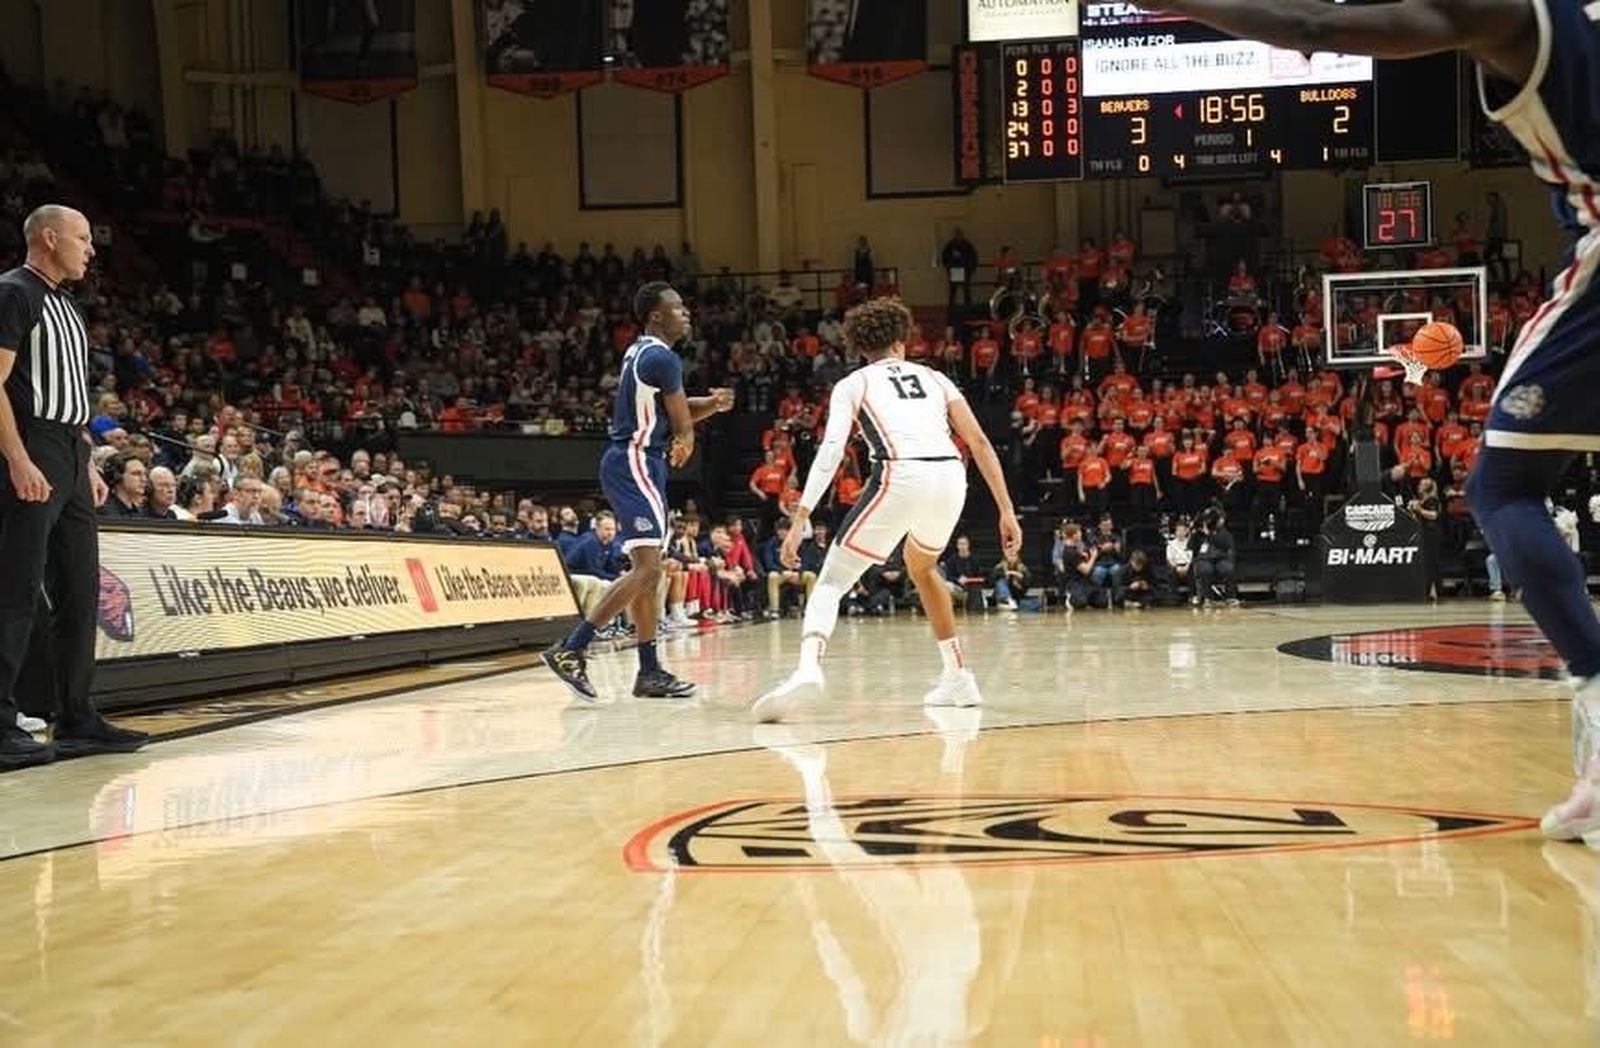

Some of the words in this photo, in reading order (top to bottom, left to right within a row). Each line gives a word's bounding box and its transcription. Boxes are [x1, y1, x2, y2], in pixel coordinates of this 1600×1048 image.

[1017, 60, 1027, 76] 0
[1041, 58, 1052, 75] 0
[1066, 57, 1077, 73] 0
[1017, 80, 1028, 97] 2
[1041, 79, 1052, 95] 0
[1066, 77, 1077, 93] 0
[1300, 87, 1357, 103] BULLDOGS
[1012, 100, 1028, 117] 13
[1042, 99, 1053, 116] 0
[1067, 98, 1077, 114] 3
[1100, 99, 1150, 113] BEAVERS
[1200, 94, 1264, 123] 18:56
[1007, 121, 1029, 138] 24
[1042, 120, 1053, 136] 0
[1067, 118, 1078, 134] 0
[1333, 105, 1350, 133] 2
[1131, 117, 1146, 144] 3
[1246, 128, 1252, 146] 1
[1008, 141, 1029, 158] 37
[1043, 140, 1053, 157] 0
[1068, 139, 1078, 155] 0
[1323, 146, 1328, 161] 1
[1139, 155, 1150, 171] 0
[1173, 154, 1185, 169] 4
[1270, 149, 1281, 163] 4
[1379, 208, 1416, 240] 27
[887, 374, 928, 400] 13
[148, 564, 212, 616] Like
[207, 566, 253, 615] the
[248, 568, 325, 616] Beavs,
[317, 573, 348, 608] we
[344, 564, 408, 604] deliver.
[434, 564, 468, 602] Like
[461, 566, 489, 600] the
[514, 574, 533, 598] we
